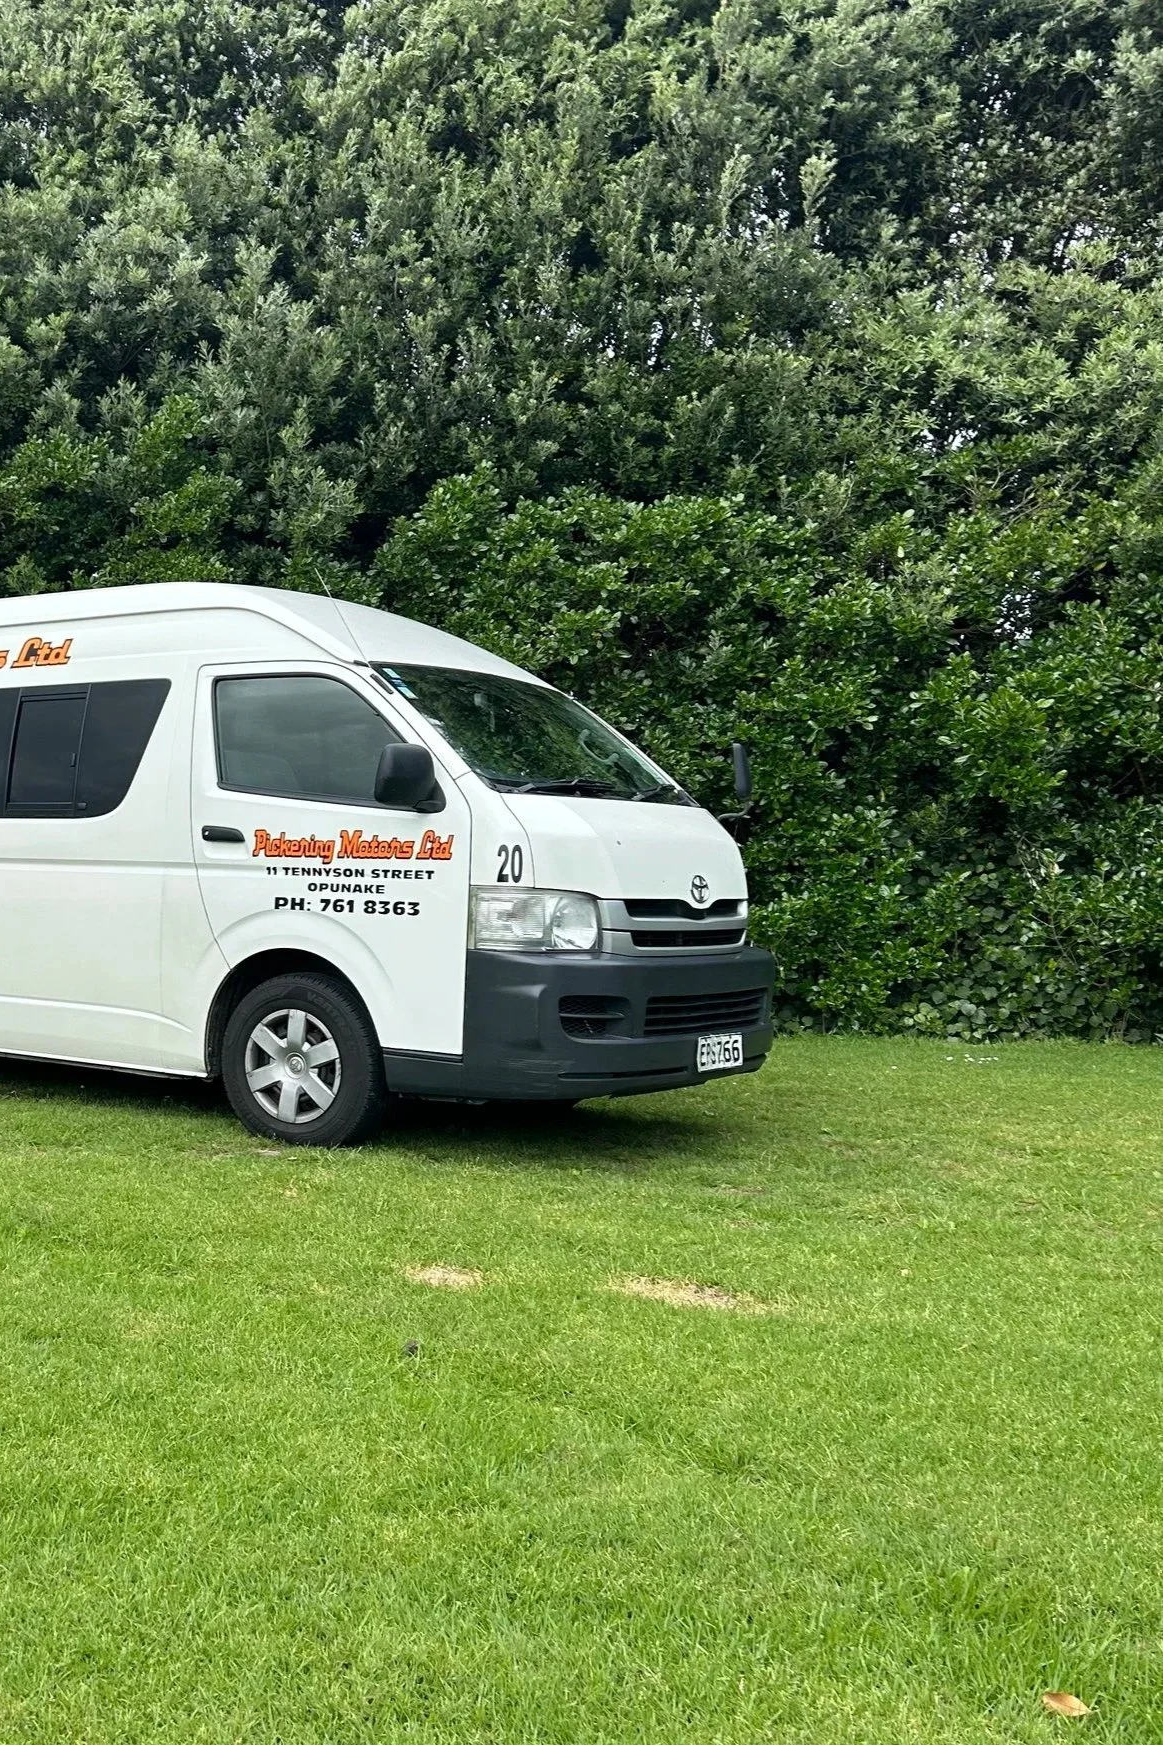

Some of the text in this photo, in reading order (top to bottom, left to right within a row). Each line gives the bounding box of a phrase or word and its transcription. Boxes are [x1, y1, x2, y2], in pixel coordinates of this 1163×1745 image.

[11, 637, 73, 669] Ltd
[252, 829, 454, 865] Pickering Motors Ltd
[266, 866, 435, 880] 11 TENNYSON STREET
[496, 844, 523, 884] 20
[307, 882, 386, 895] OPUNAKE
[274, 896, 421, 917] PH: 761 8363
